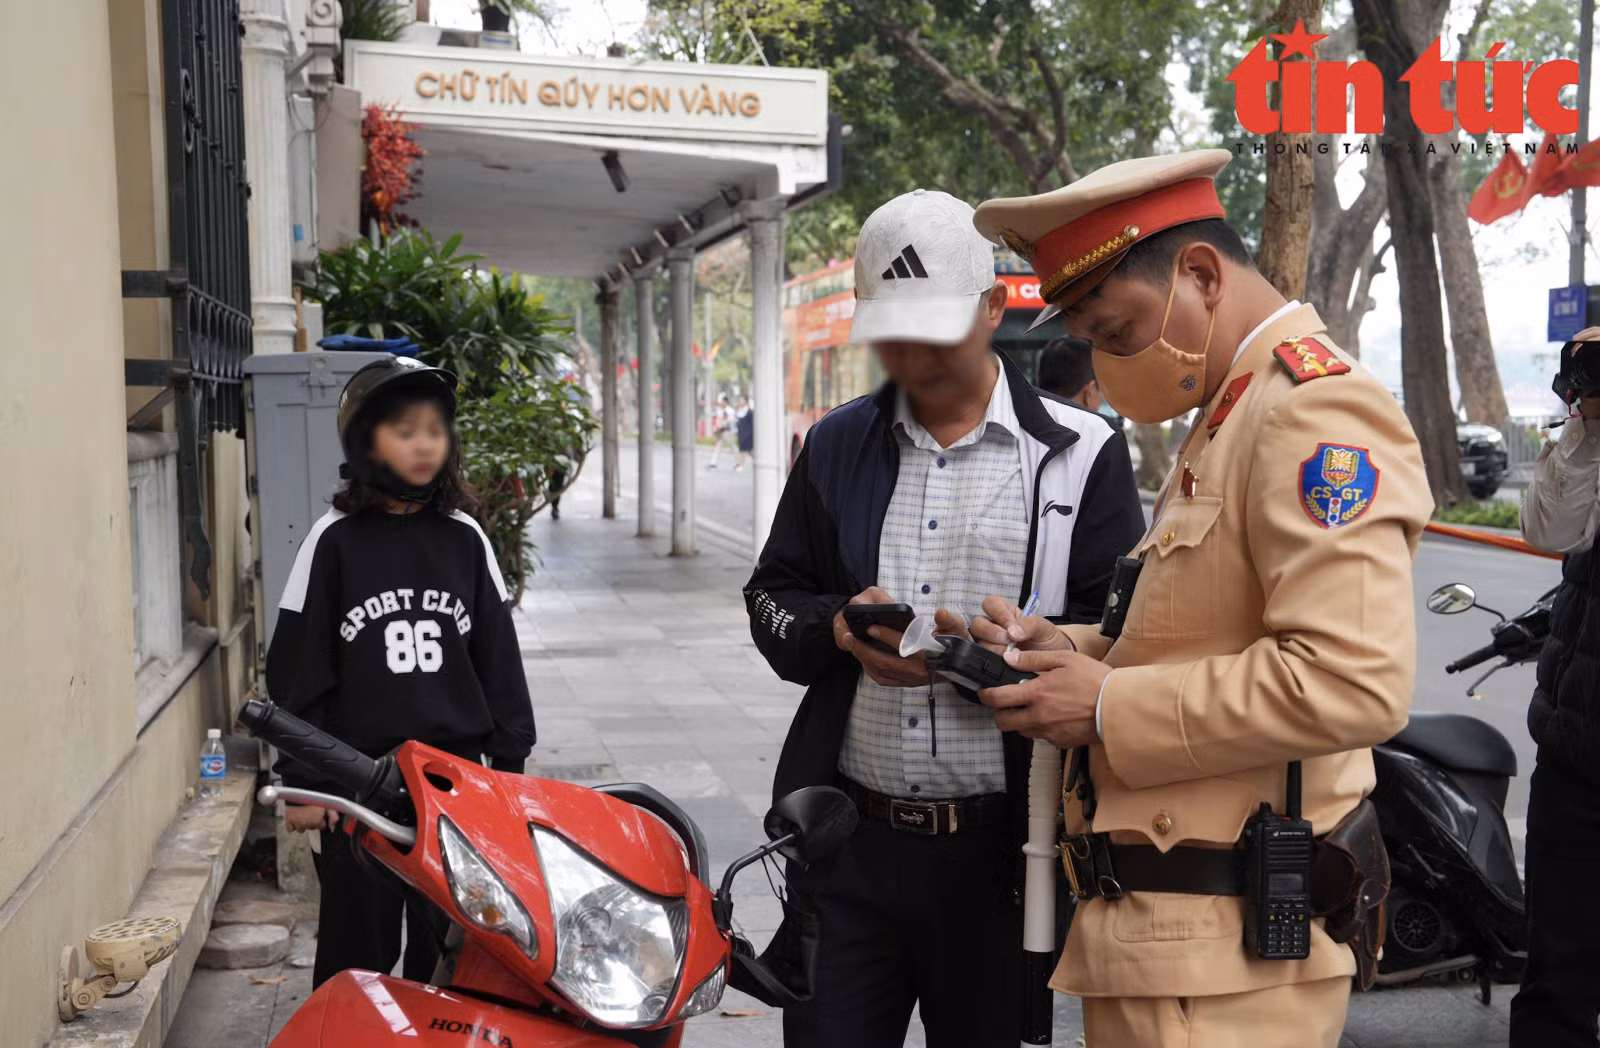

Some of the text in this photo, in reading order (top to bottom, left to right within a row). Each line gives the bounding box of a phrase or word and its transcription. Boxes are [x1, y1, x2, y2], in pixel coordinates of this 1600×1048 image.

[415, 69, 480, 100] CHỮ
[486, 70, 528, 104] TÍN
[538, 75, 600, 108] QÚY
[679, 81, 761, 118] VÀNG
[339, 588, 472, 642] SPORT CLUB
[384, 619, 444, 674] 86
